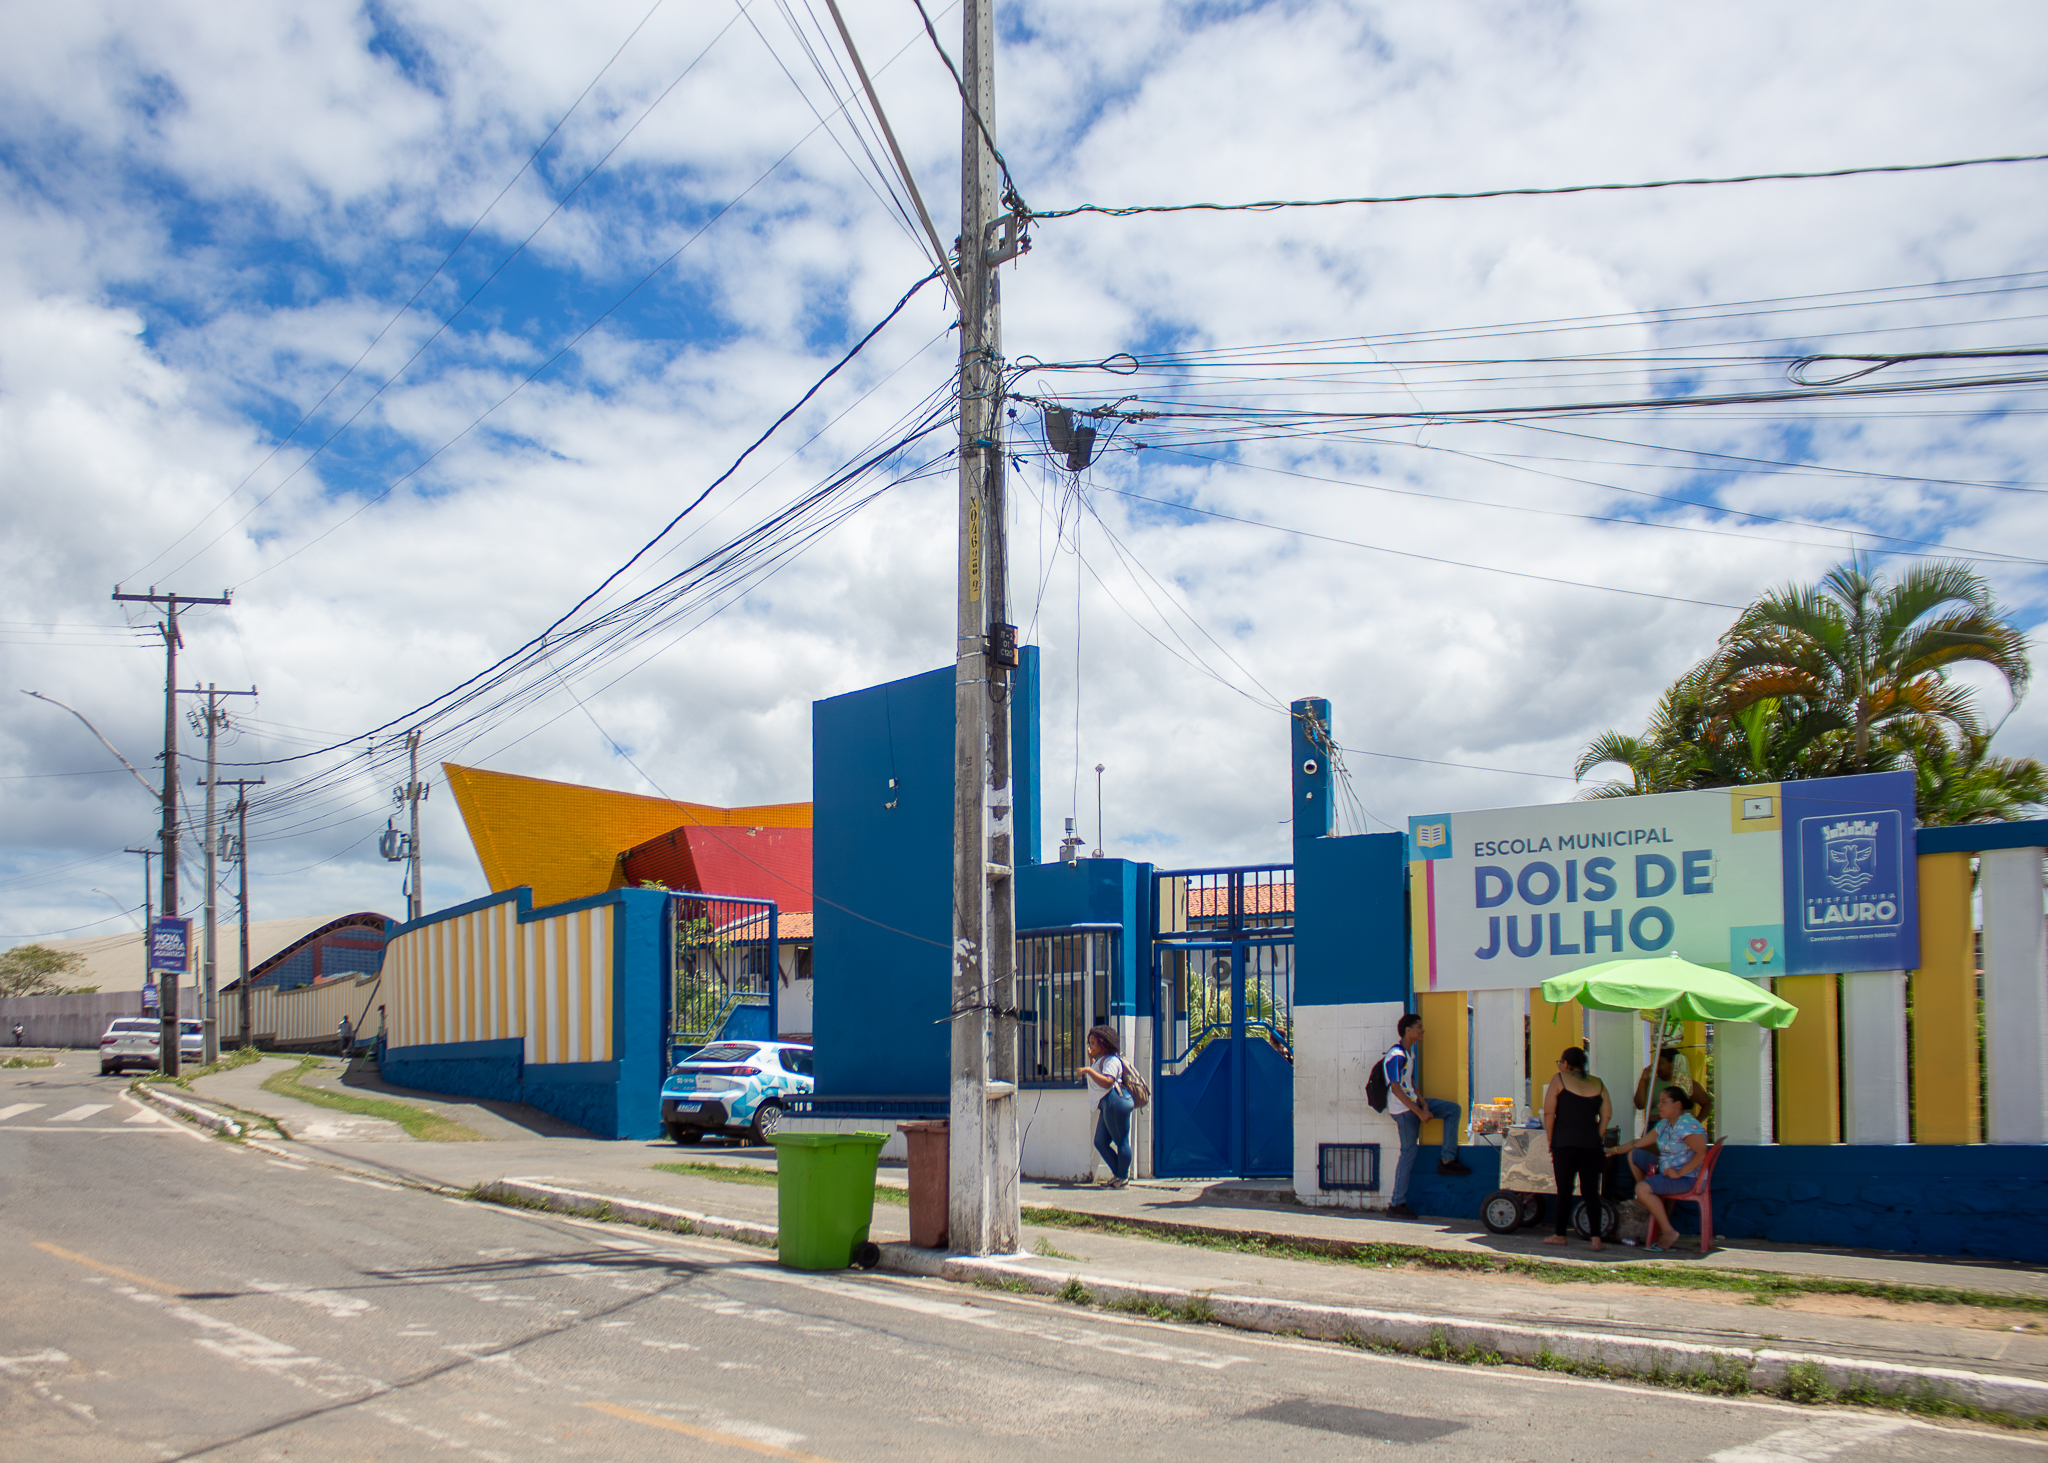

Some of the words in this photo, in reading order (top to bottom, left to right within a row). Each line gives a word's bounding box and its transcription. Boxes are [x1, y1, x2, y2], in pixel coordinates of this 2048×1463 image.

[1475, 837, 1553, 857] ESCOLA
[1558, 827, 1674, 851] MUNICIPAL
[1475, 856, 1618, 909] DOIS
[1635, 849, 1714, 898] DE
[1809, 893, 1896, 904] PREFEITURA
[1808, 901, 1897, 925] LAURO
[154, 933, 181, 942] NOVA
[1474, 905, 1675, 960] JULHO
